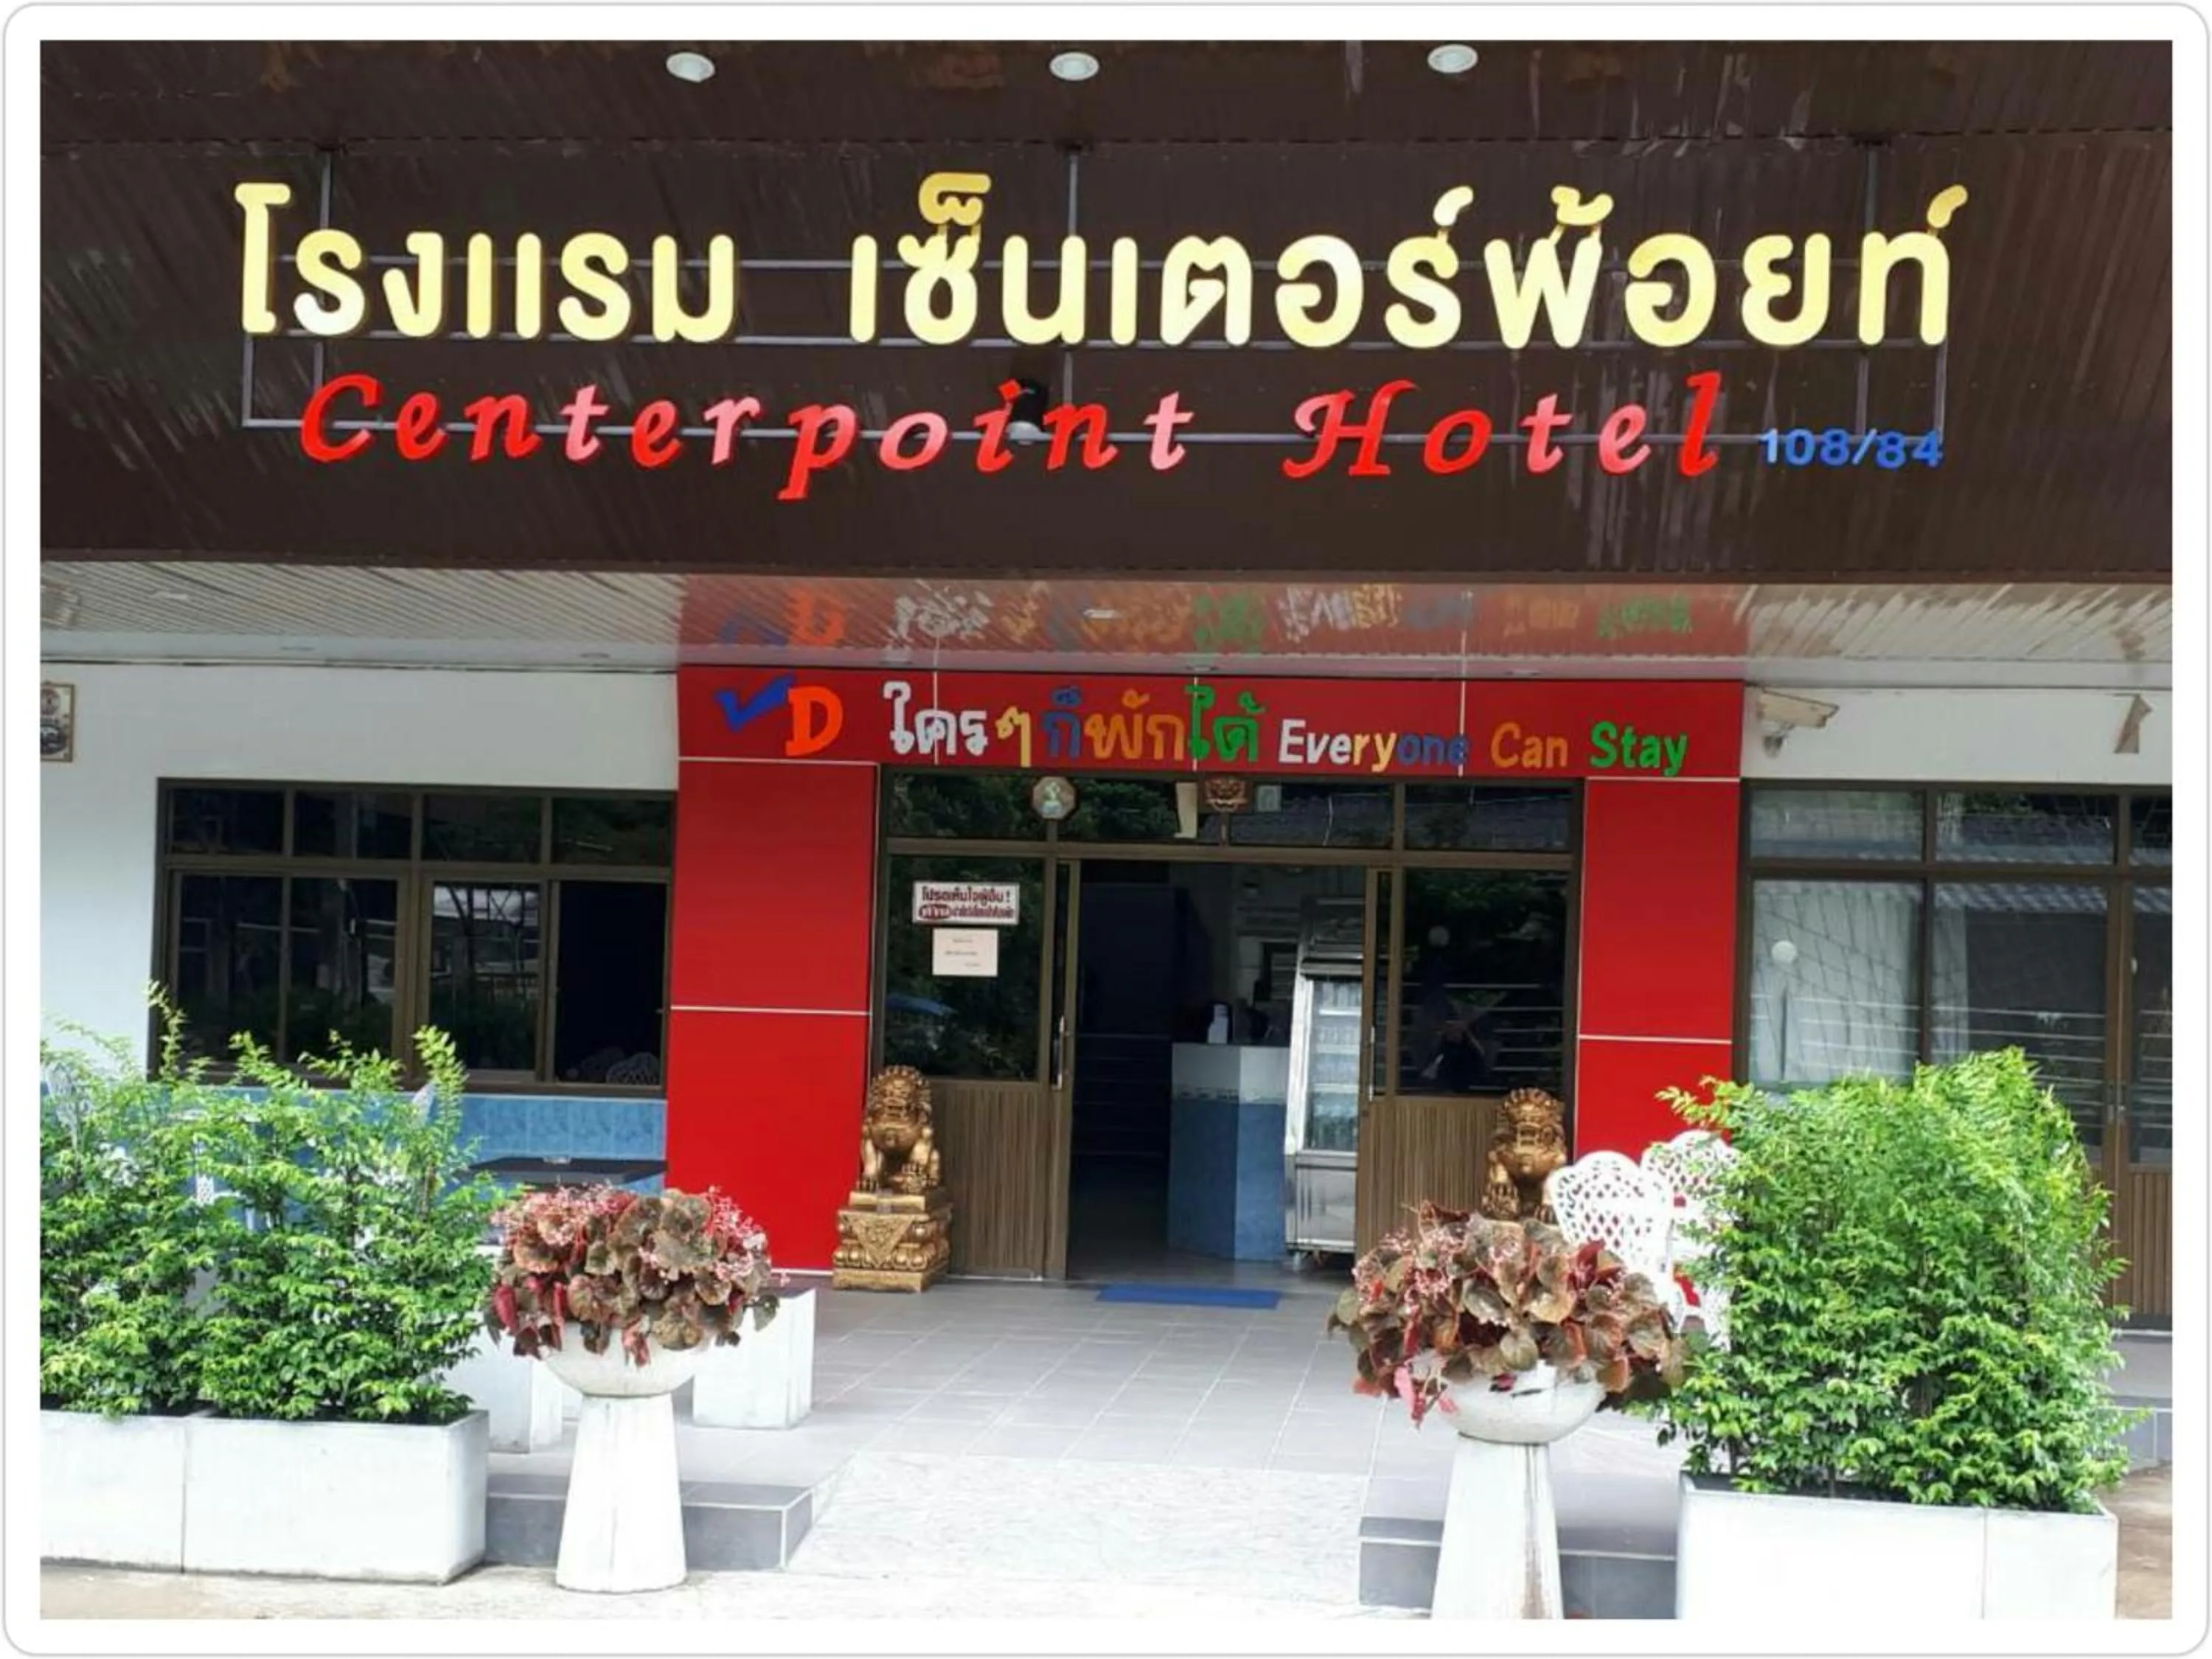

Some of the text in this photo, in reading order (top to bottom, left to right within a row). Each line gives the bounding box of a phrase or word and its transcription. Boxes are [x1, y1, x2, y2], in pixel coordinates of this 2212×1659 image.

[234, 172, 1969, 350] โรงแรม เซ็นเตอร์พ้อยท์
[299, 370, 1722, 501] Centerpoint Hotel
[1761, 428, 1945, 470] 108/84
[1278, 718, 1688, 777] Everyone Can Stay
